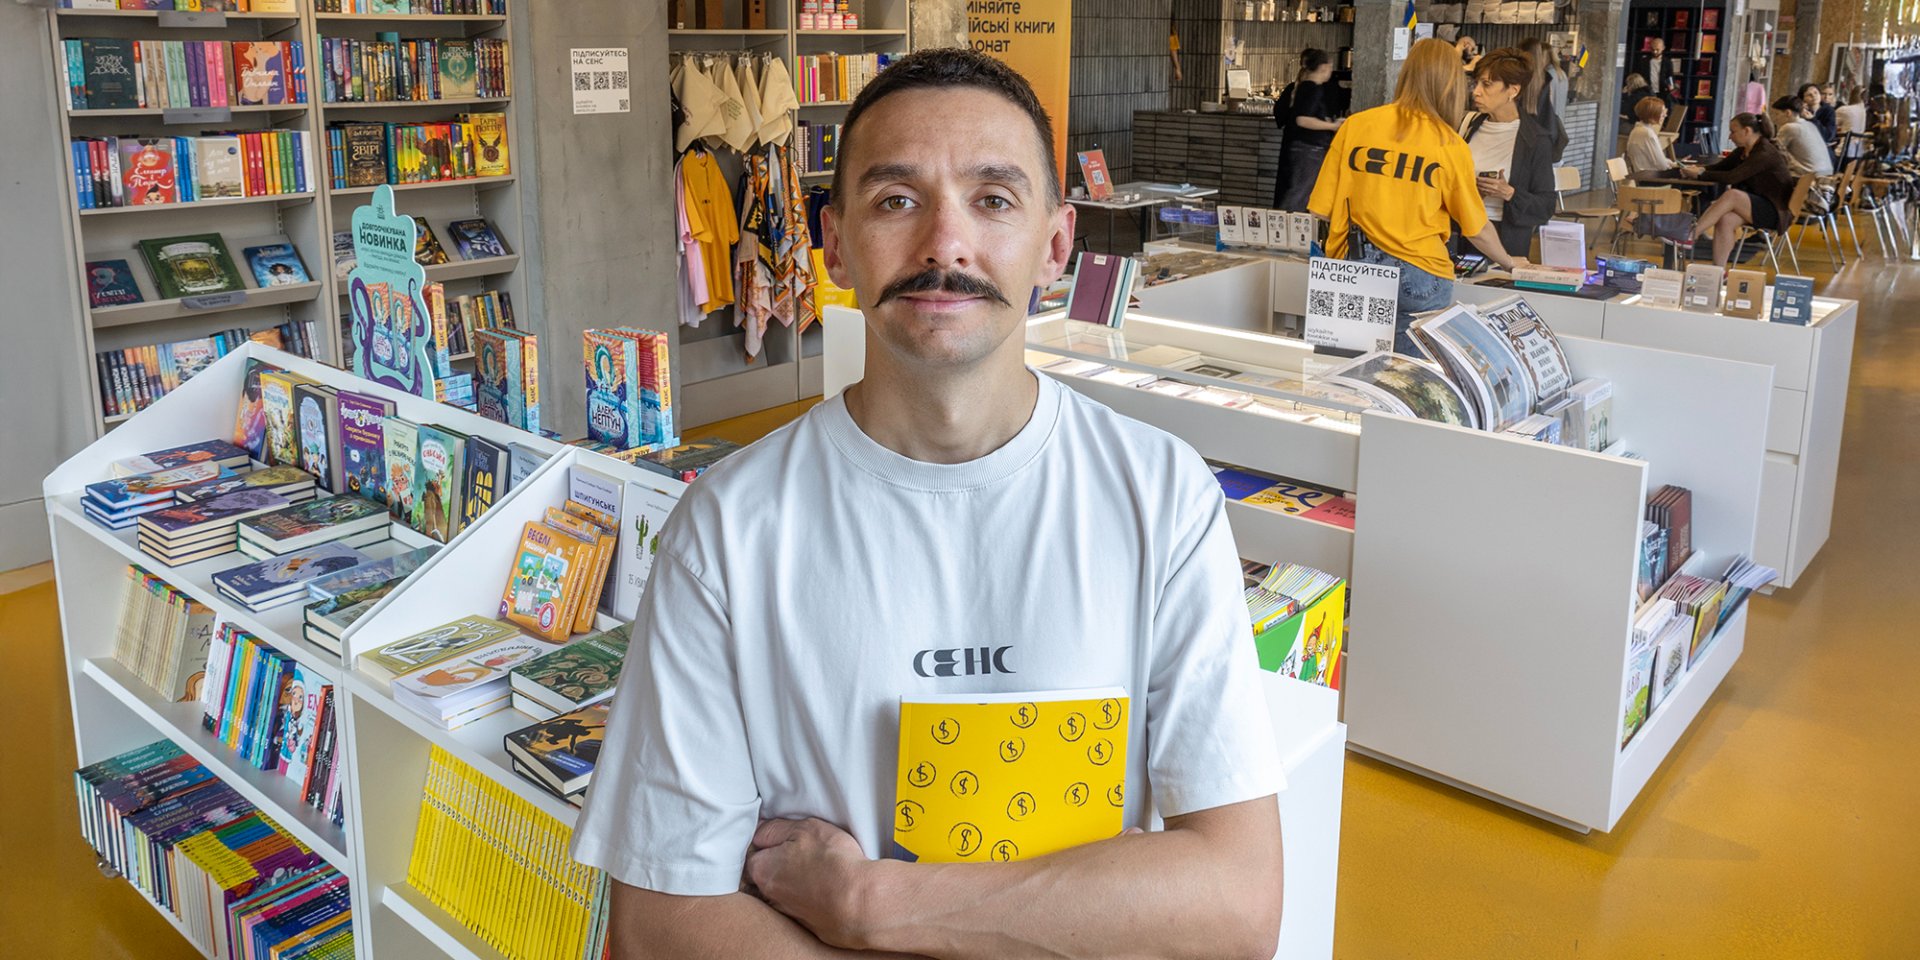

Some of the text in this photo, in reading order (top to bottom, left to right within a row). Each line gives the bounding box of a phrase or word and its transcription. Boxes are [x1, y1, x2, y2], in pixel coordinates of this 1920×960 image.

[1014, 21, 1056, 34] книги
[572, 50, 628, 58] ПІДПИСУЙТЕСЬ
[359, 225, 408, 253] НОВИНКА
[361, 222, 407, 237] ДОВГООЧІКУВАНА
[1310, 271, 1358, 285] НА СЕНС
[1311, 259, 1398, 280] ПІДПИСУЙТЕСЬ
[596, 404, 616, 418] АЛЕКС
[592, 412, 622, 431] НЕПТУН
[574, 489, 616, 513] ШПИГУНСЬКЕ
[527, 527, 552, 547] ВЕСЕЛІ
[913, 645, 1017, 678] СЕНС
